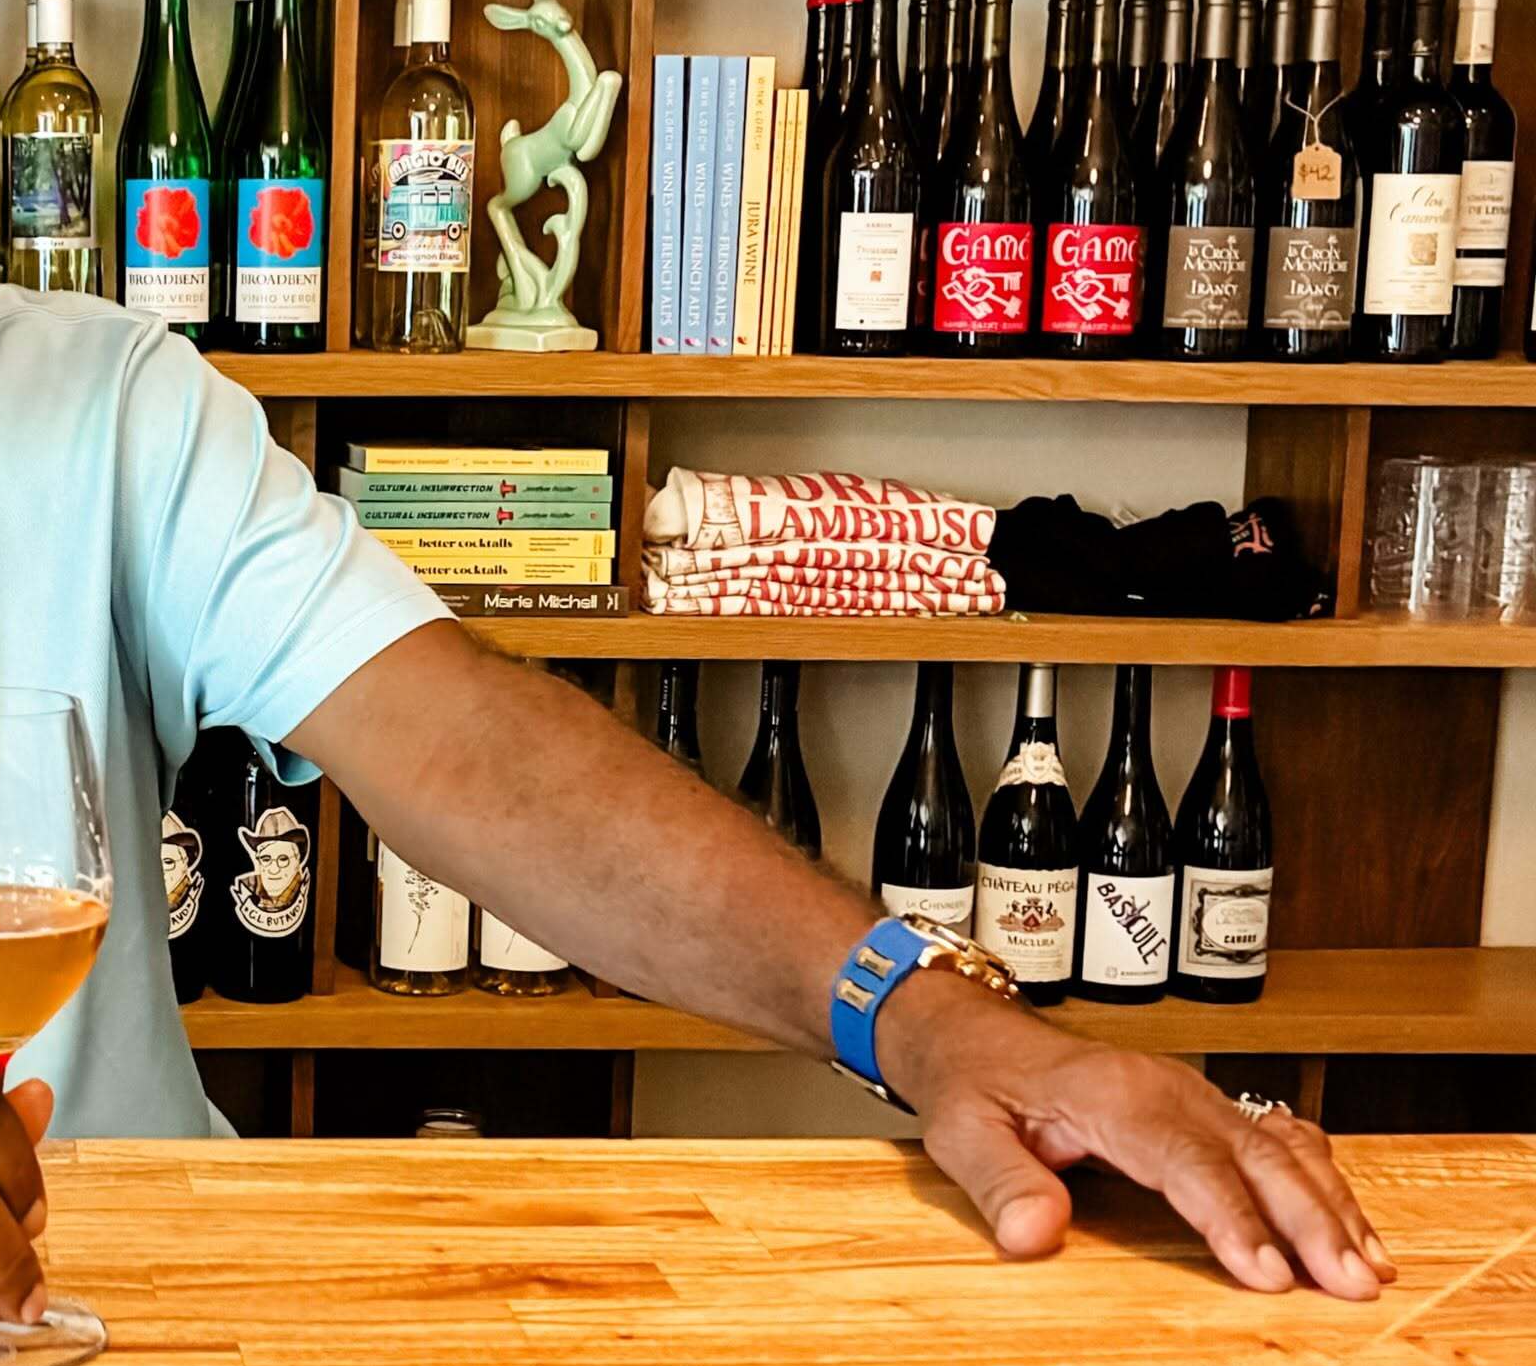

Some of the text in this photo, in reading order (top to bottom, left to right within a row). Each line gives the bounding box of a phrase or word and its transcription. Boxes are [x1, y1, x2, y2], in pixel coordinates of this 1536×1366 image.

[661, 160, 675, 207] WINES
[694, 162, 708, 208] WINES
[720, 162, 735, 208] WINES
[1296, 164, 1336, 185] $42
[743, 200, 761, 286] JURA WINE
[128, 272, 207, 288] BROADBENT
[240, 272, 319, 288] BROADBENT
[659, 293, 674, 327] ALPS
[687, 295, 702, 327] ALPS
[714, 296, 728, 327] ALPS
[418, 537, 514, 549] better cocktails
[413, 564, 509, 576] better cocktails
[483, 593, 598, 610] Marie Mitchell
